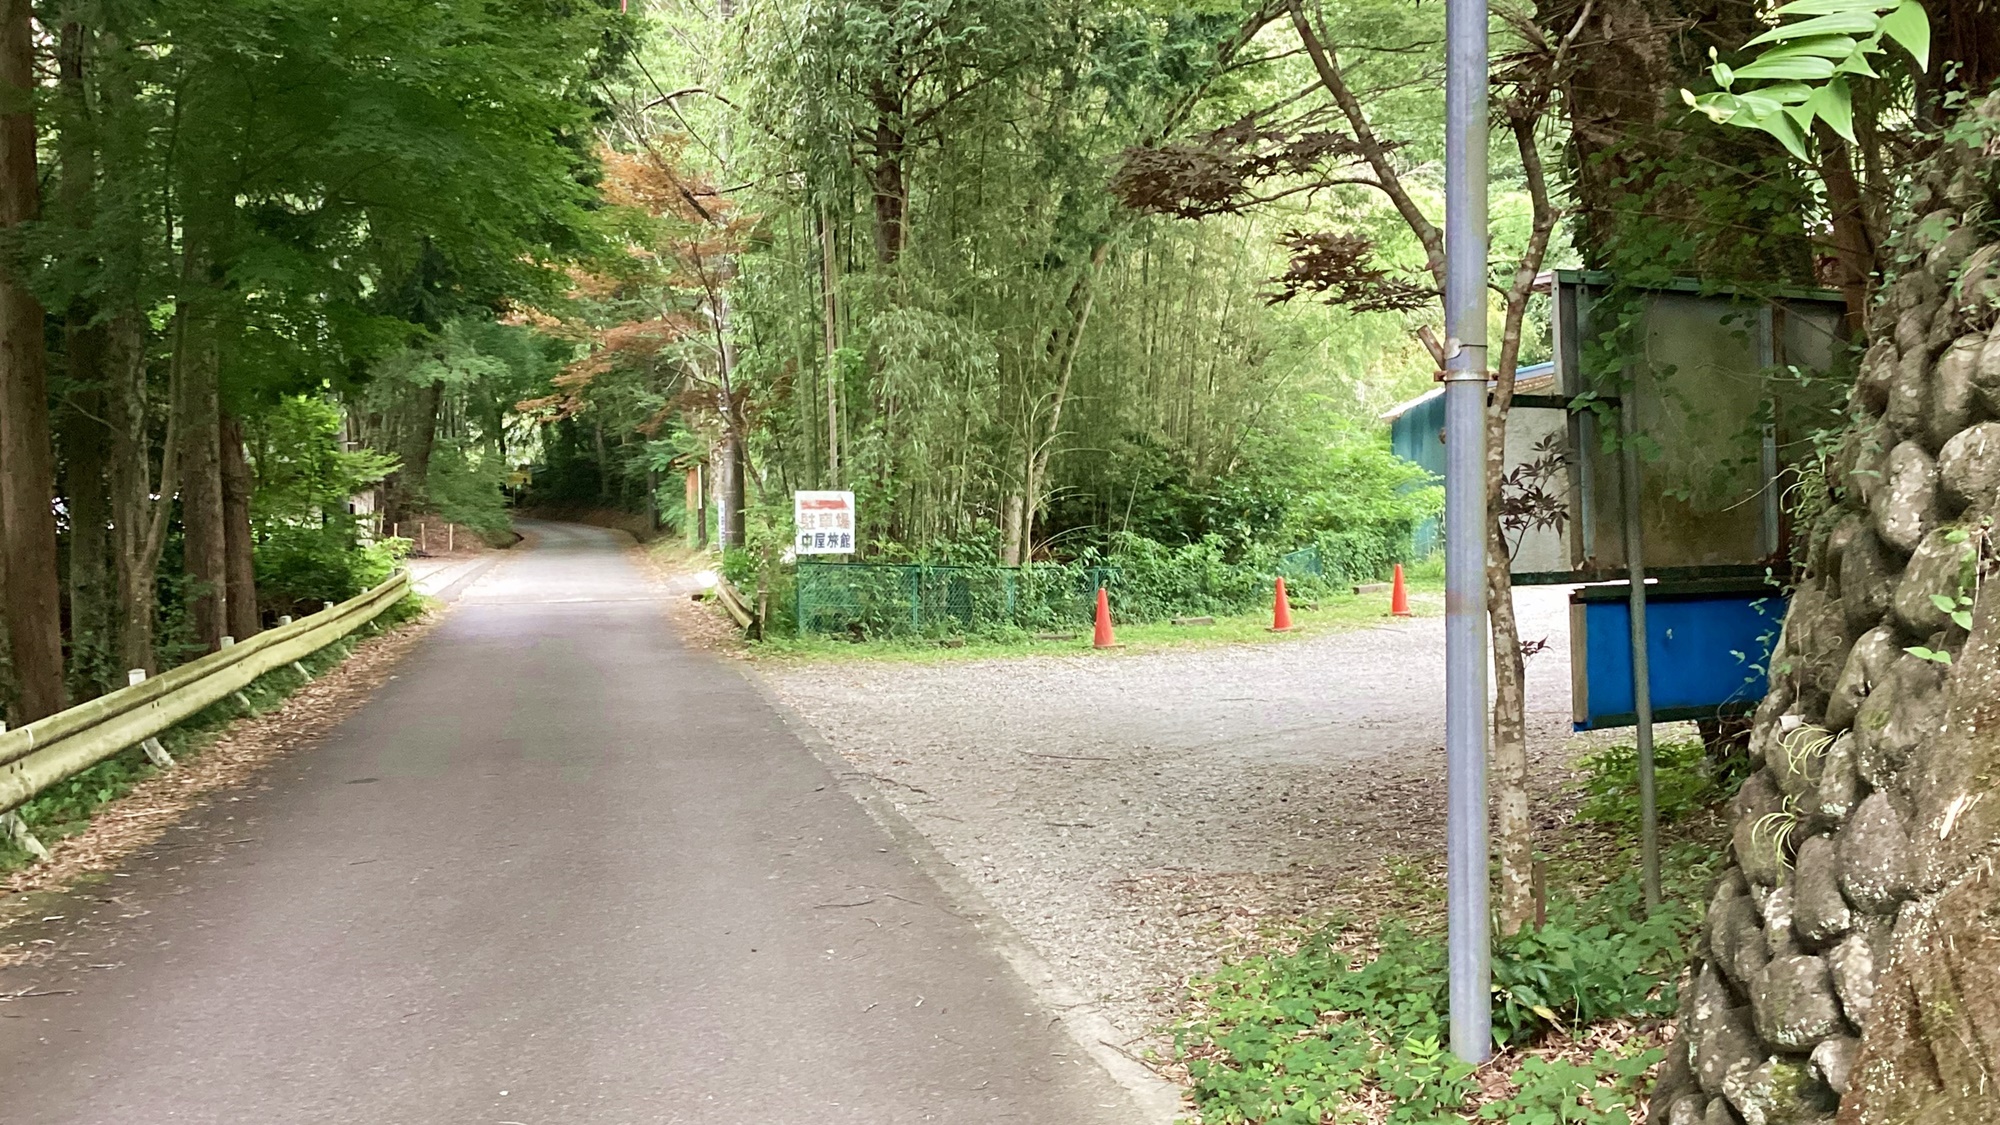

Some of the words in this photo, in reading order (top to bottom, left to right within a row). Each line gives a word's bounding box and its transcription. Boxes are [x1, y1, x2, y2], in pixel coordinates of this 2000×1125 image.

[800, 512, 850, 530] 駐車場
[801, 532, 851, 549] 中屋旅館
